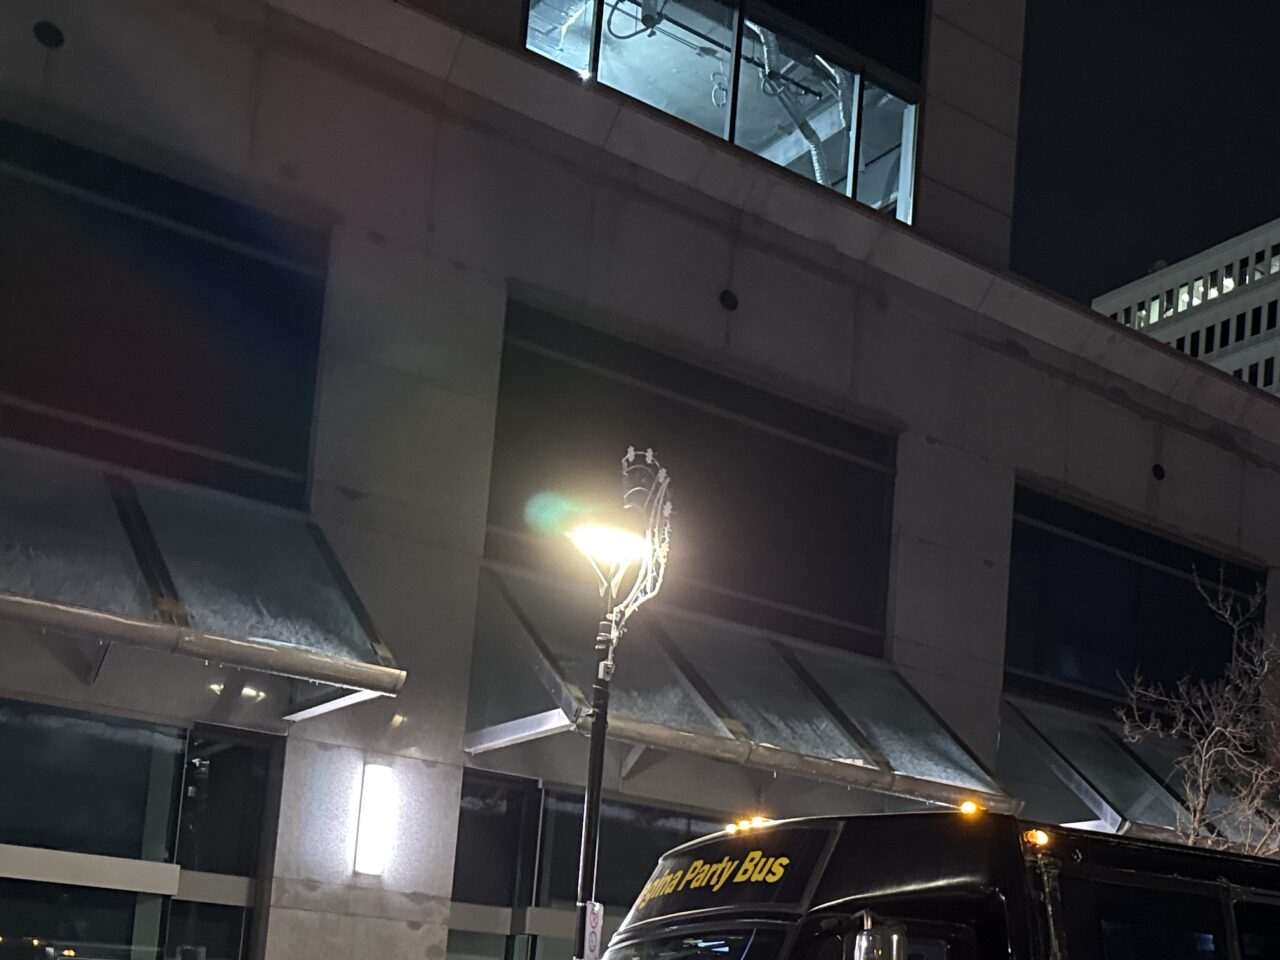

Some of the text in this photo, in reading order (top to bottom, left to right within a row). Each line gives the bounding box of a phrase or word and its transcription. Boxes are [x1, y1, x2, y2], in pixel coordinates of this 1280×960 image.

[638, 851, 790, 909] gina Party Bus
